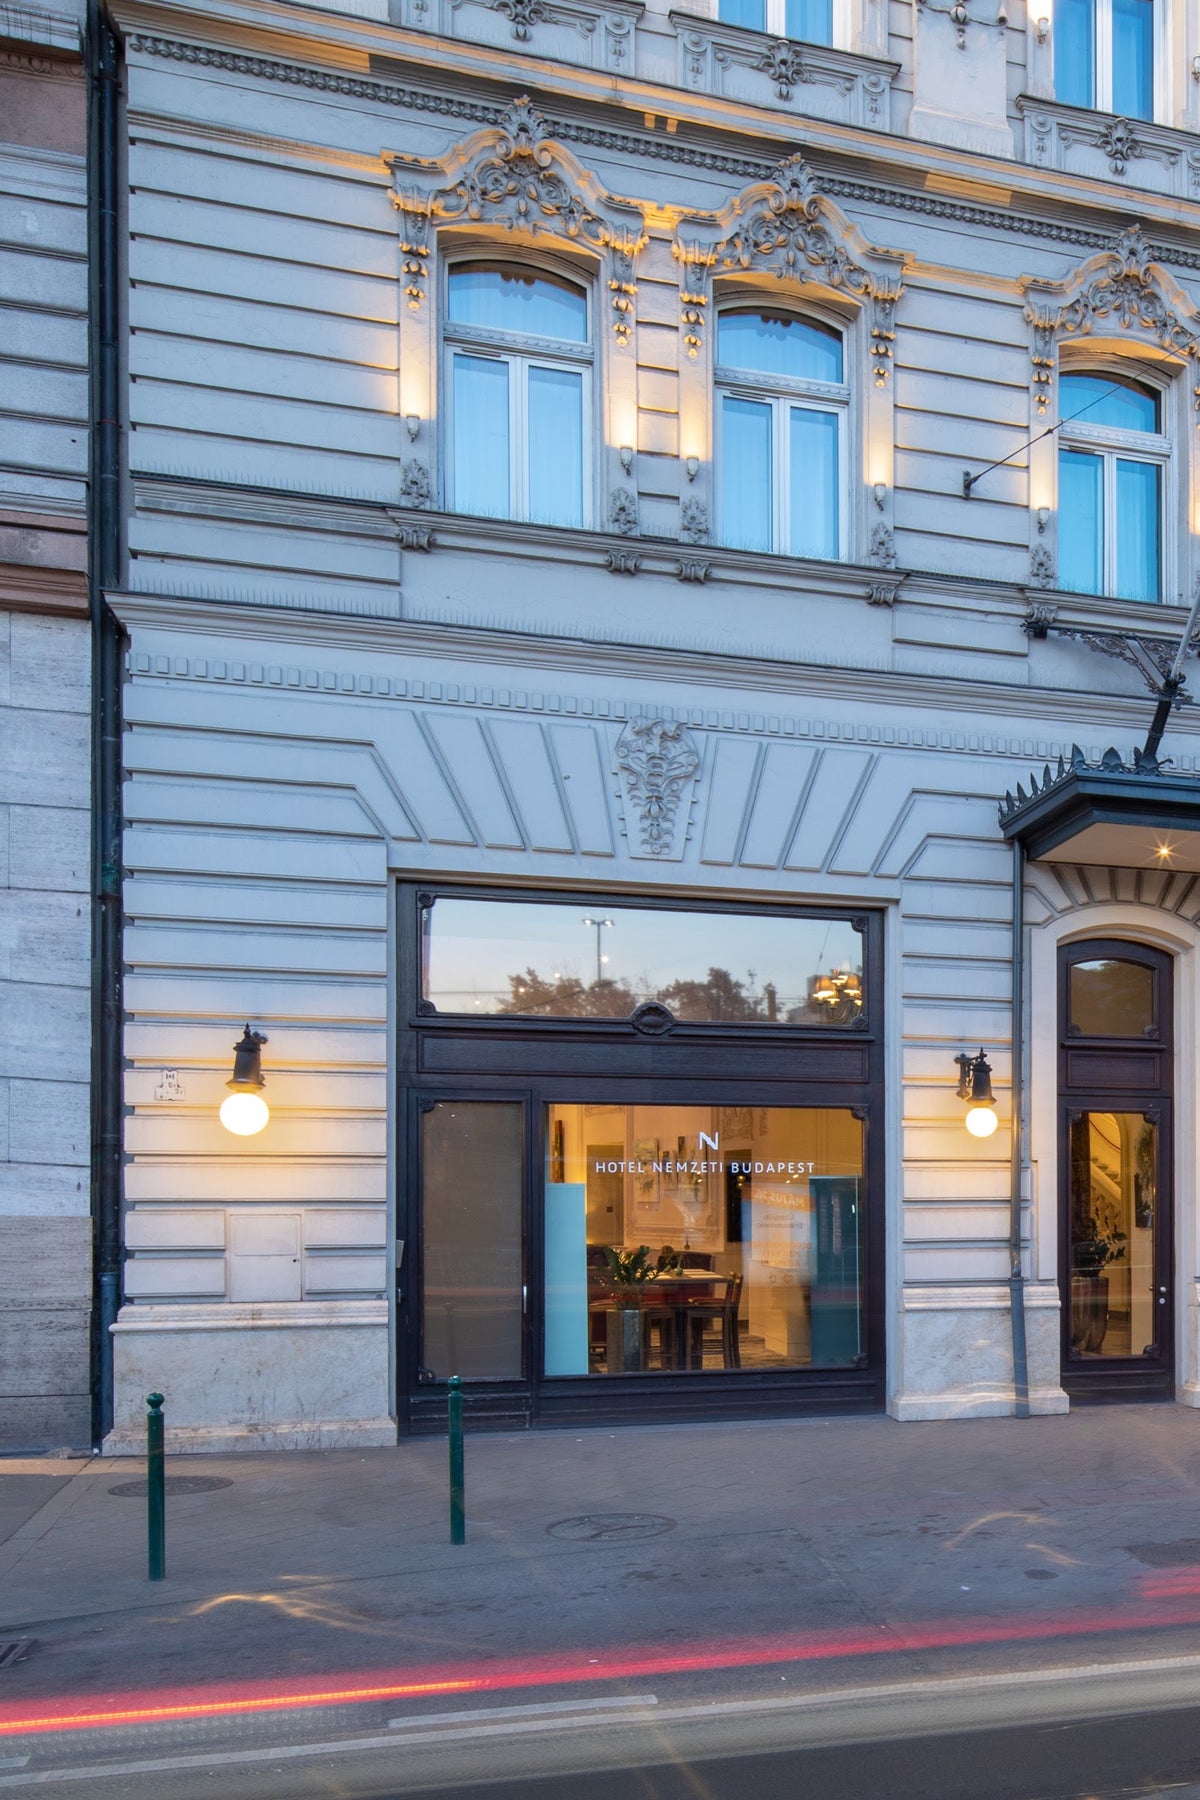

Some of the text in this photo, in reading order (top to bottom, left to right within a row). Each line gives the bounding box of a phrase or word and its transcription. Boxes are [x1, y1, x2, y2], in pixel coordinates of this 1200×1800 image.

[699, 1131, 719, 1150] N
[595, 1161, 815, 1174] HOTEL NEMZETI BUDAPEST
